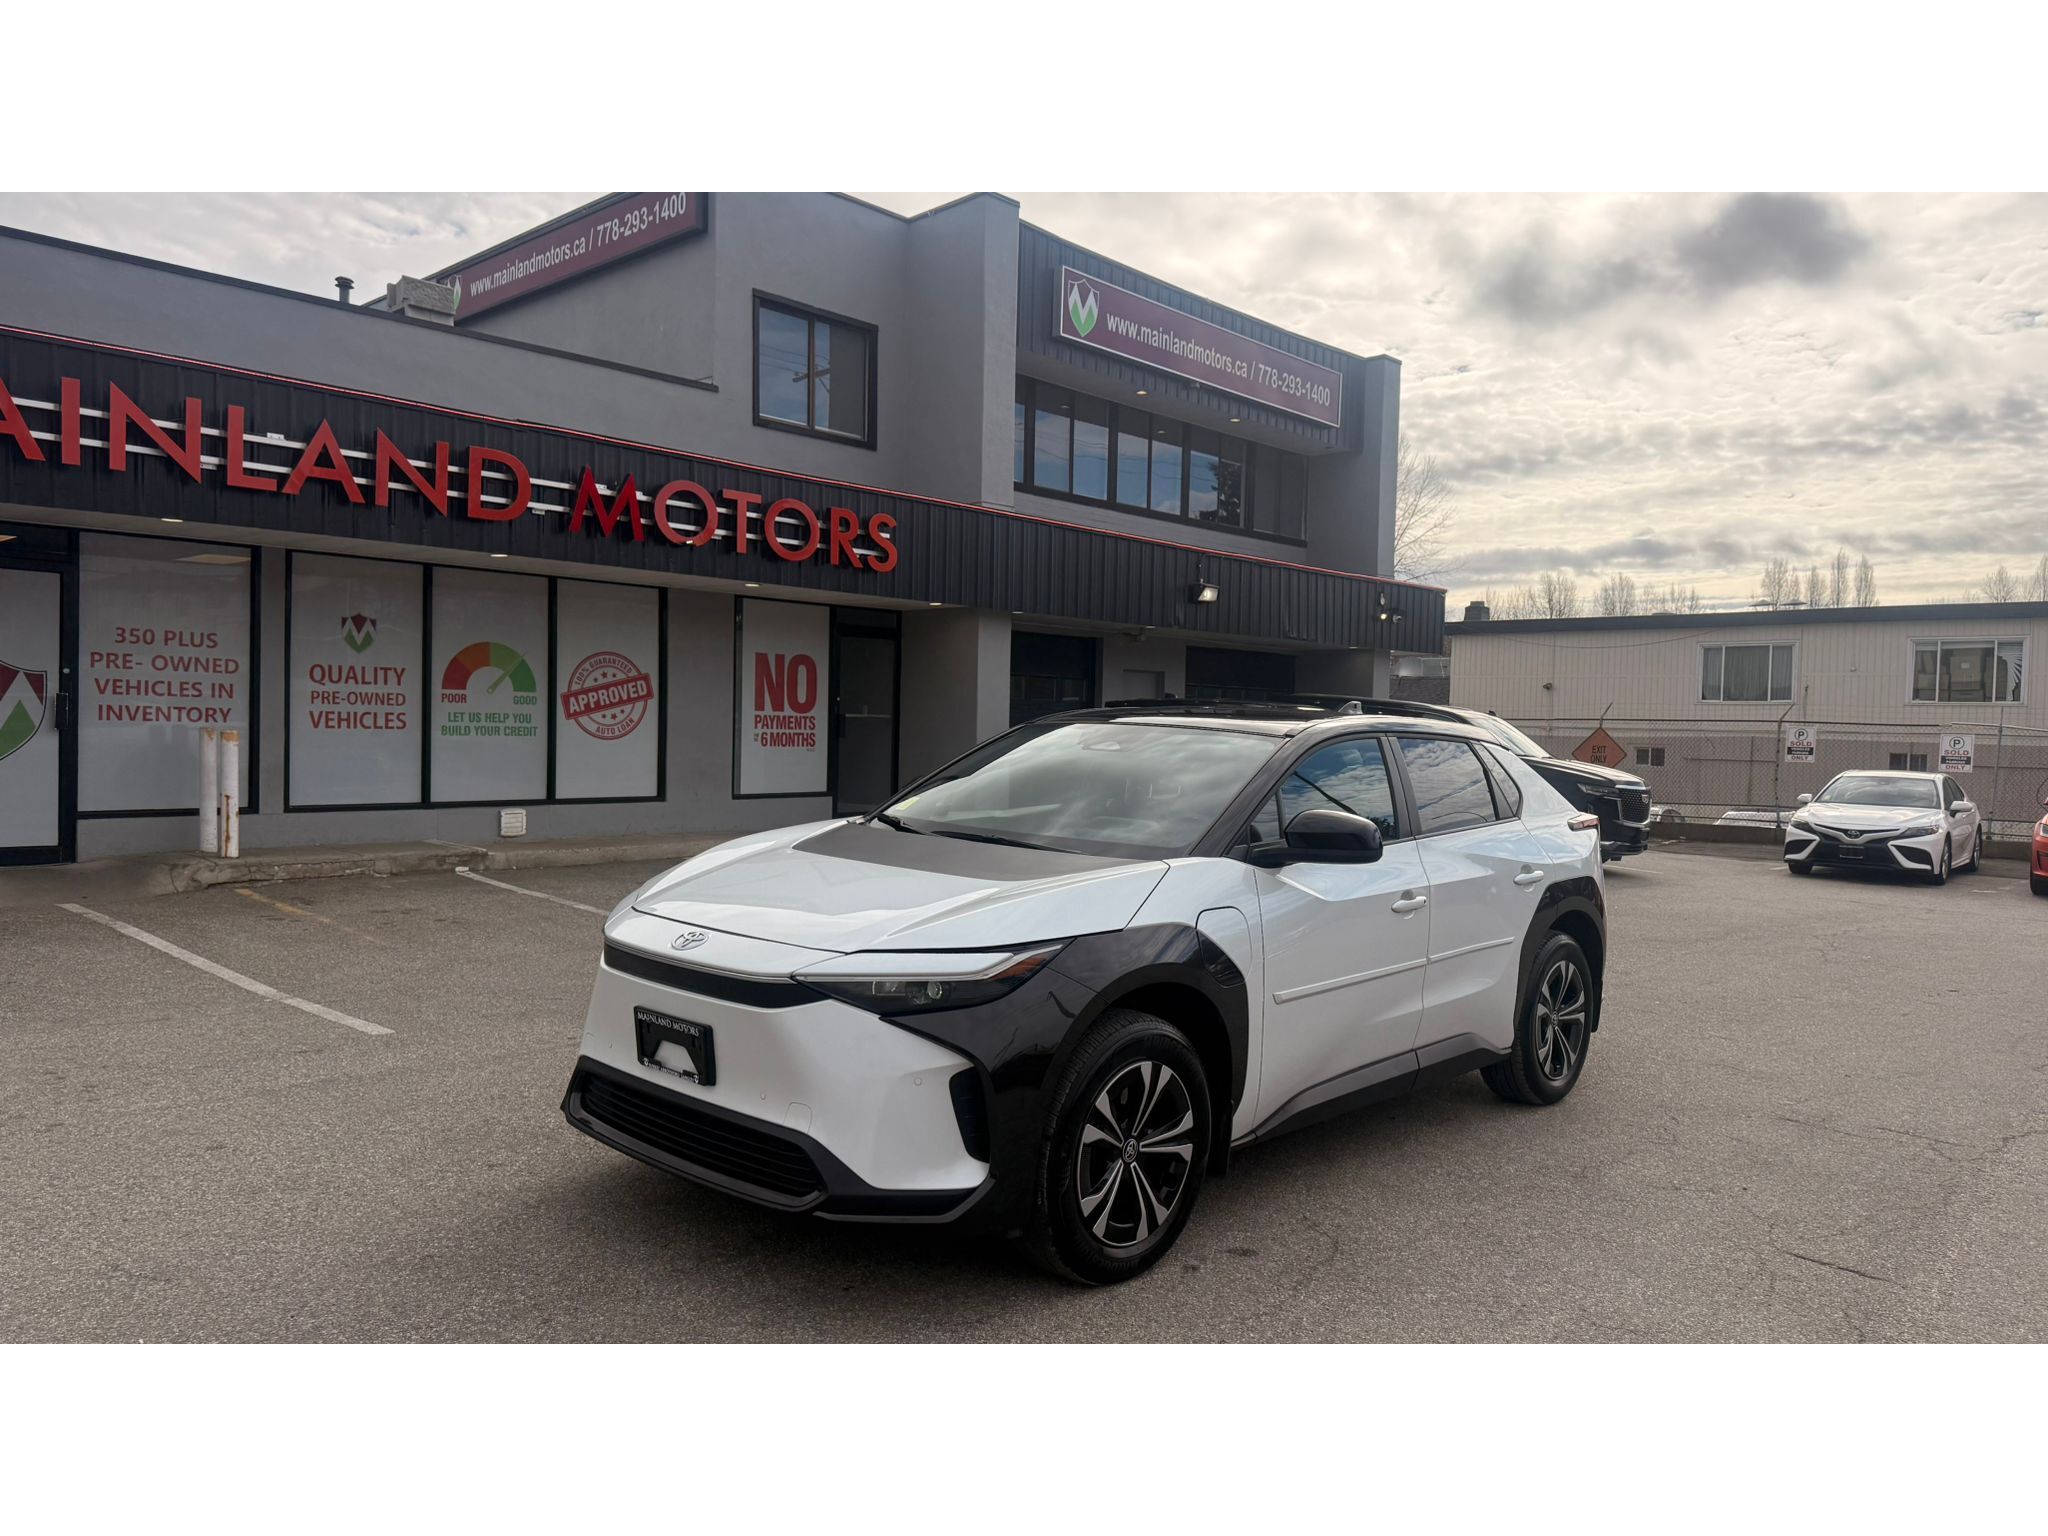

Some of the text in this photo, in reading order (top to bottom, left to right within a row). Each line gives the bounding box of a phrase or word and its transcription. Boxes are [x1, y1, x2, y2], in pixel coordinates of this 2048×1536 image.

[470, 236, 586, 297] www.mainlandmotors.ca
[597, 192, 687, 247] 778-293-1400
[1107, 313, 1248, 379] www.mainlandmotors.ca
[1258, 364, 1331, 406] 778-293-1400
[569, 464, 898, 573] MOTORS
[114, 627, 218, 648] 350 PLUS
[90, 652, 240, 674] PRE- OWNED
[589, 657, 633, 674] GUARANTEED
[308, 664, 407, 686] QUALITY
[754, 652, 817, 714] NO
[94, 678, 234, 699] VEHICLES IN
[569, 680, 648, 714] APPROVED
[310, 690, 406, 707] PRE-OWNED
[441, 693, 467, 704] POOR
[513, 695, 538, 706] GOOD
[98, 704, 232, 723] INVENTORY
[309, 710, 407, 730] VEHICLES
[447, 711, 532, 724] LET US HELP YOU
[754, 715, 816, 731] PAYMENTS
[441, 725, 538, 737] BUILD YOUR CREDIT
[595, 717, 636, 735] AUTO LOAN
[760, 732, 768, 747] 6
[769, 732, 816, 748] MONTHS
[1592, 745, 1607, 754] EXIT
[1590, 754, 1607, 763] ONLY
[637, 1011, 699, 1037] MAINLAND MOTORS
